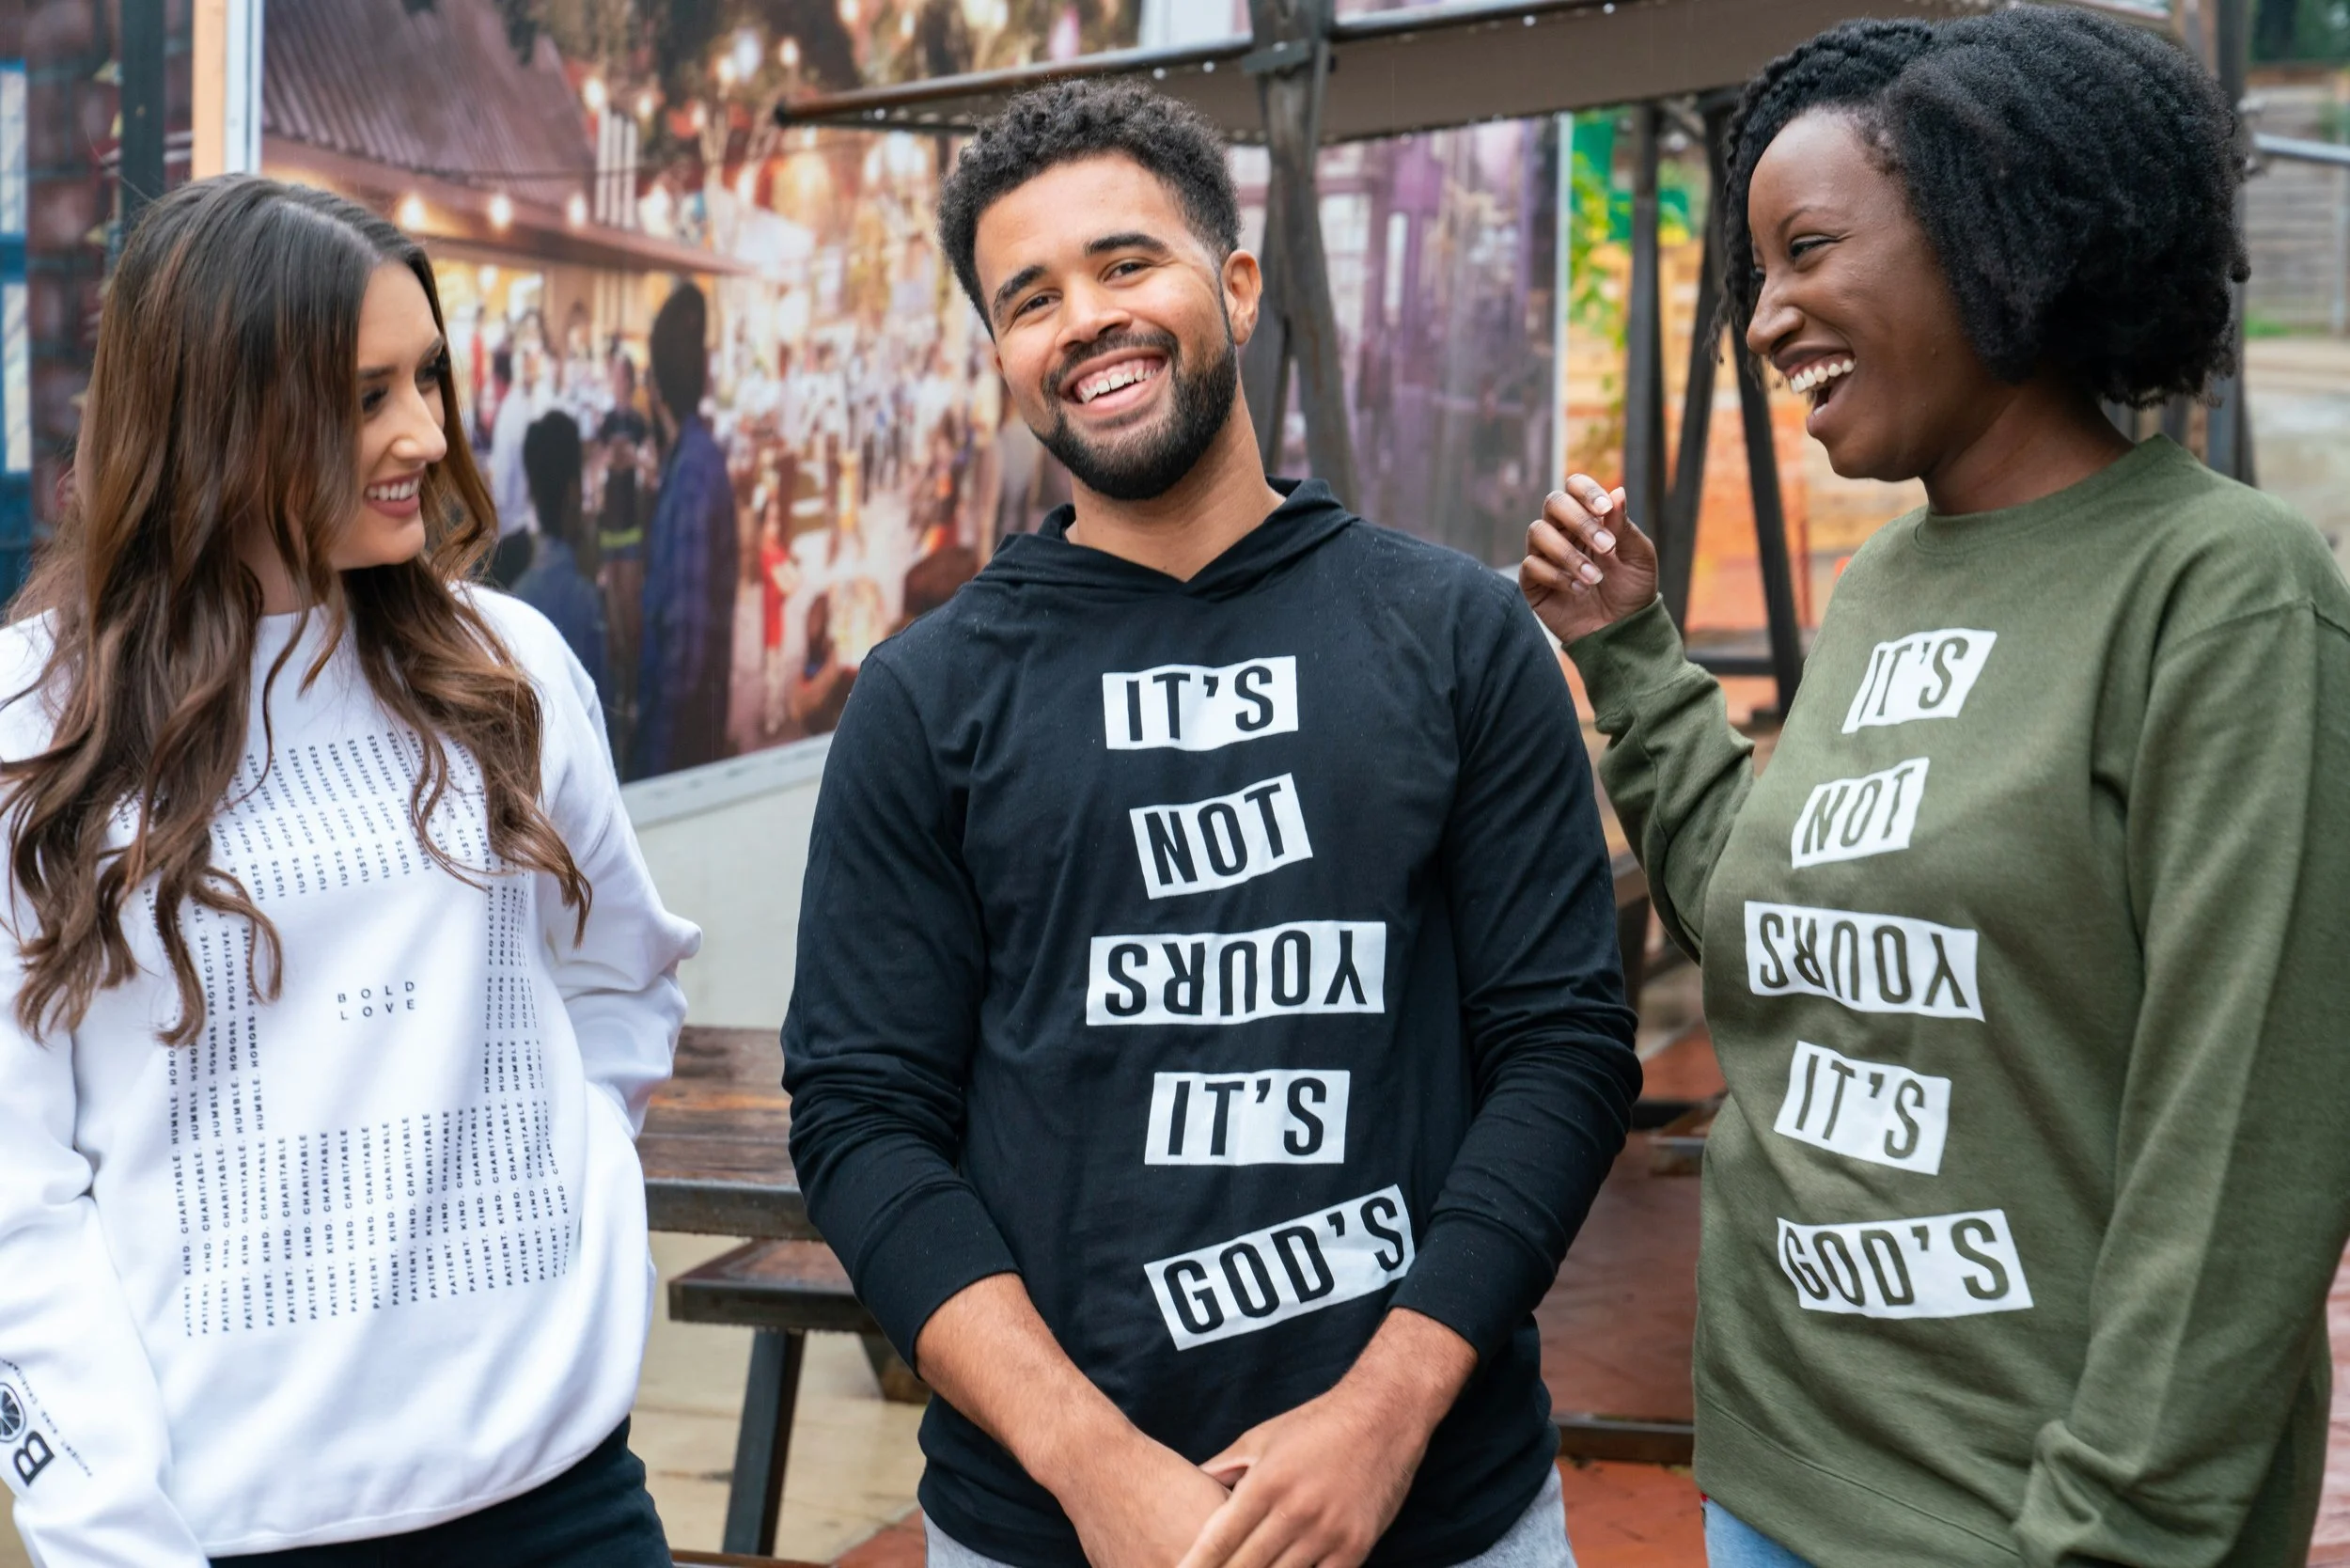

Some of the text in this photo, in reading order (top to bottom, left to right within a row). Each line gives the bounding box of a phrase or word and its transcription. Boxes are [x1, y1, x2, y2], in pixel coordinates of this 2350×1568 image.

[1124, 664, 1276, 743] IT'S
[1856, 635, 1971, 728] IT'S
[1143, 782, 1292, 886] NOT
[1801, 766, 1907, 856] NOT
[337, 980, 415, 1004] BOLD
[1104, 929, 1369, 1018] YOURS
[1759, 911, 1971, 1011] YOURS
[339, 998, 415, 1022] LOVE
[1167, 1075, 1328, 1157] IT'S
[1794, 1053, 1926, 1161] IT'S
[1163, 1195, 1406, 1336] GOD'S
[1783, 1215, 2012, 1308] GOD'S
